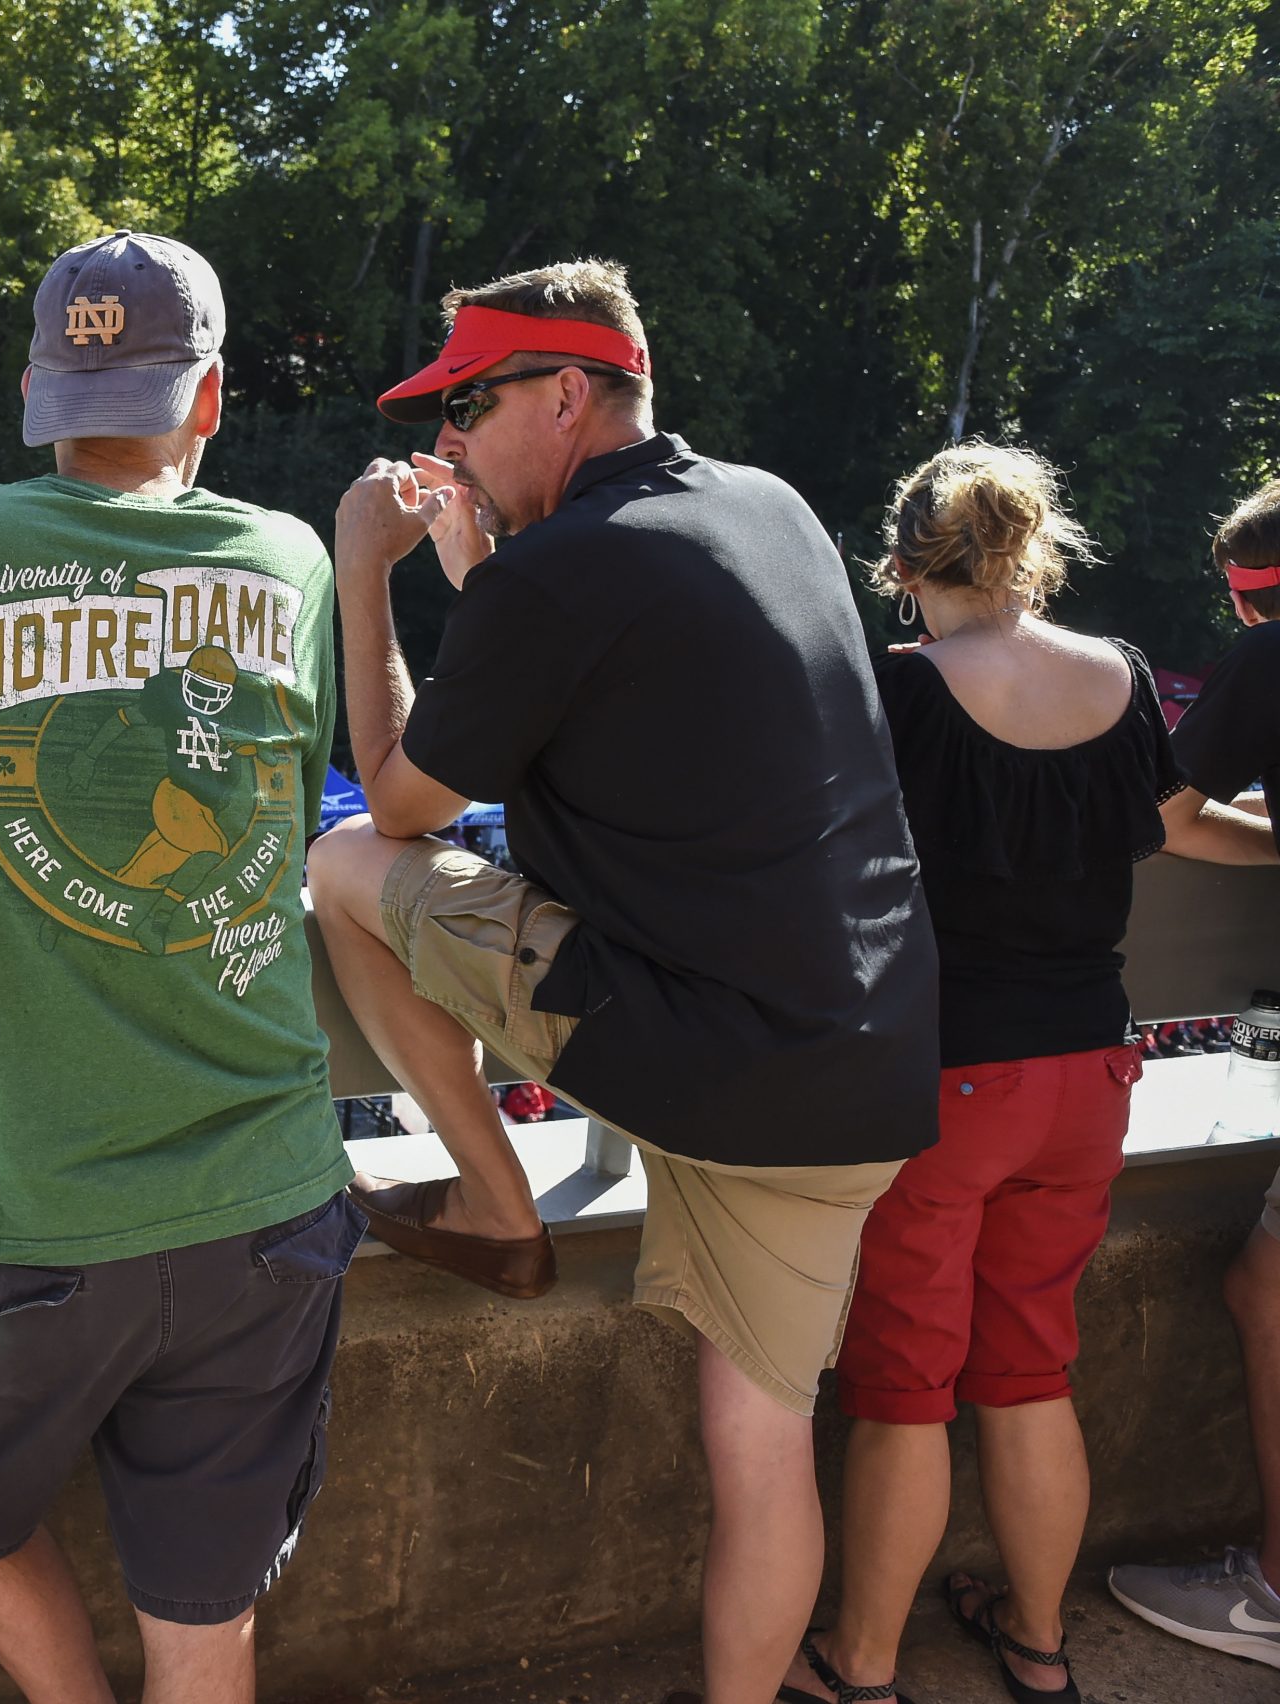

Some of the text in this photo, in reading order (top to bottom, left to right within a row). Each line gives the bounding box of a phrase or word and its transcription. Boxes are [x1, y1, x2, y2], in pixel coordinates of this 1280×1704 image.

[100, 560, 127, 593] of
[170, 582, 288, 666] DAME
[4, 817, 281, 927] HERE COME THE IRISH
[210, 911, 288, 959] Twenty
[218, 939, 283, 997] Fifteen
[1232, 1018, 1280, 1041] POWER
